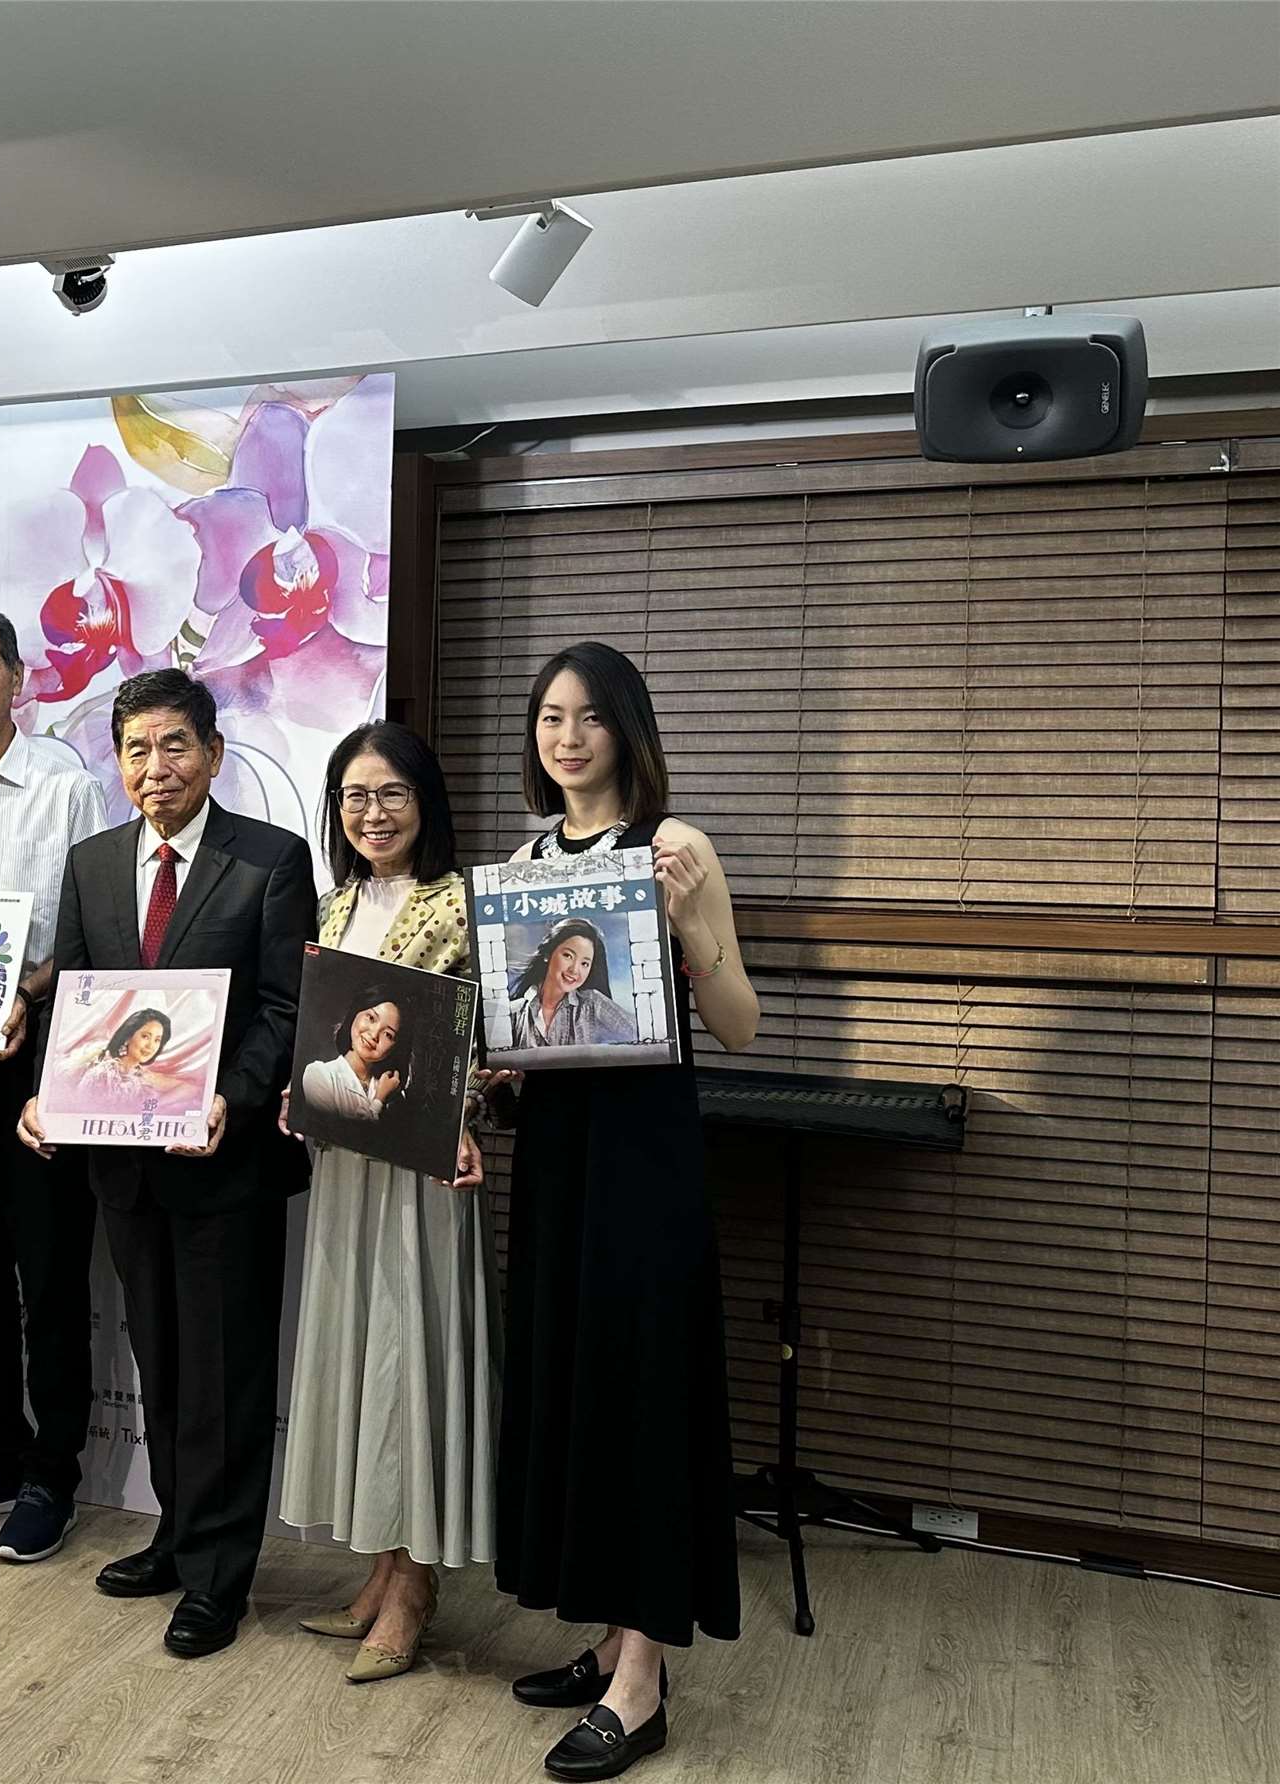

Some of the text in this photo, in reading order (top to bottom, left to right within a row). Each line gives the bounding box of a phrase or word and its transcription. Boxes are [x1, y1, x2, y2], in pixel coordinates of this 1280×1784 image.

[513, 885, 627, 917] 小城故事
[453, 985, 471, 1037] 鄧麗君
[81, 1119, 137, 1137] TERESA
